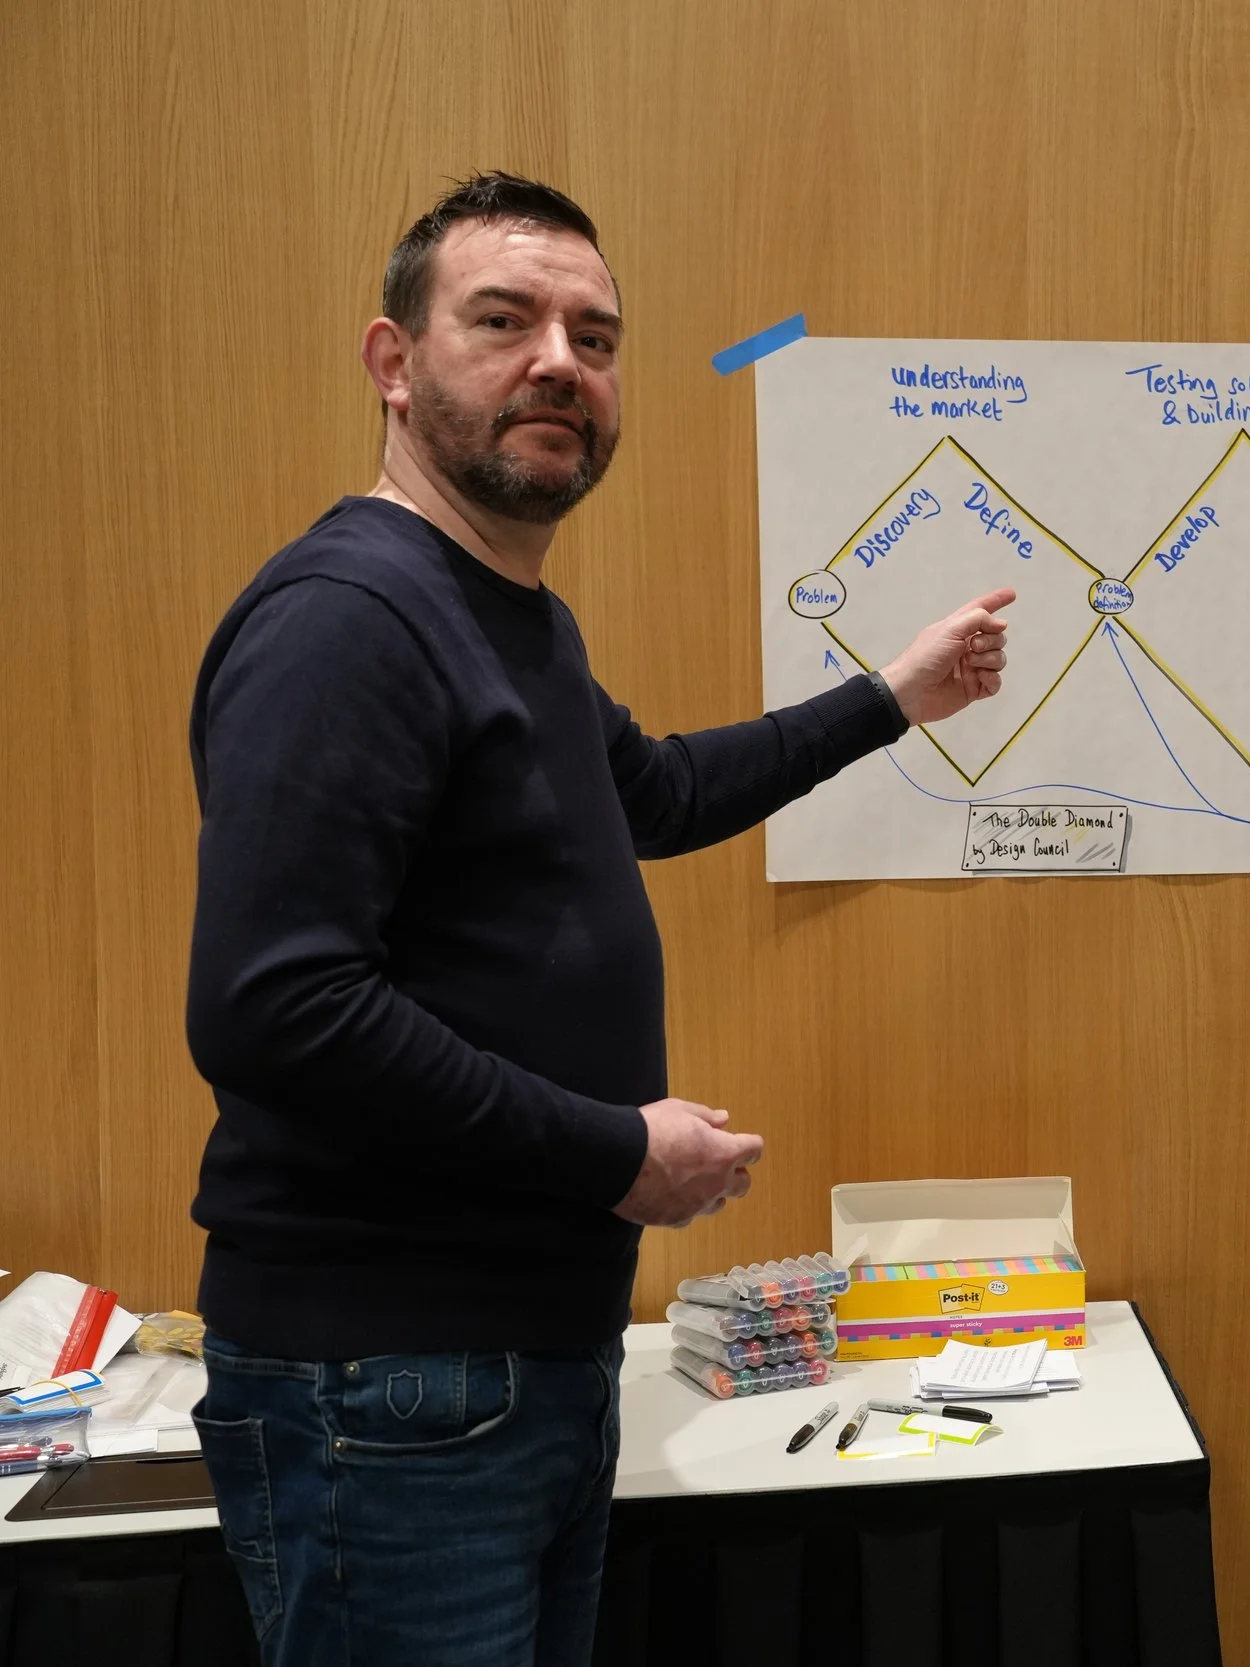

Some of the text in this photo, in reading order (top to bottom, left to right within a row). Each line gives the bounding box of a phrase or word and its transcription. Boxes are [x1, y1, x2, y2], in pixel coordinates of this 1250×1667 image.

[1125, 363, 1218, 400] Testing
[889, 396, 1003, 422] the market
[1161, 400, 1182, 425] &
[853, 487, 942, 569] Discovery
[963, 481, 1034, 560] Define
[1153, 505, 1221, 573] Develop
[794, 587, 838, 605] Problem
[1095, 581, 1132, 600] Problem
[982, 808, 1114, 829] The Double Diamond
[972, 837, 1070, 864] by Design Council
[942, 1292, 980, 1303] Post-it
[966, 1320, 983, 1328] sticky
[1063, 1335, 1083, 1347] 3M
